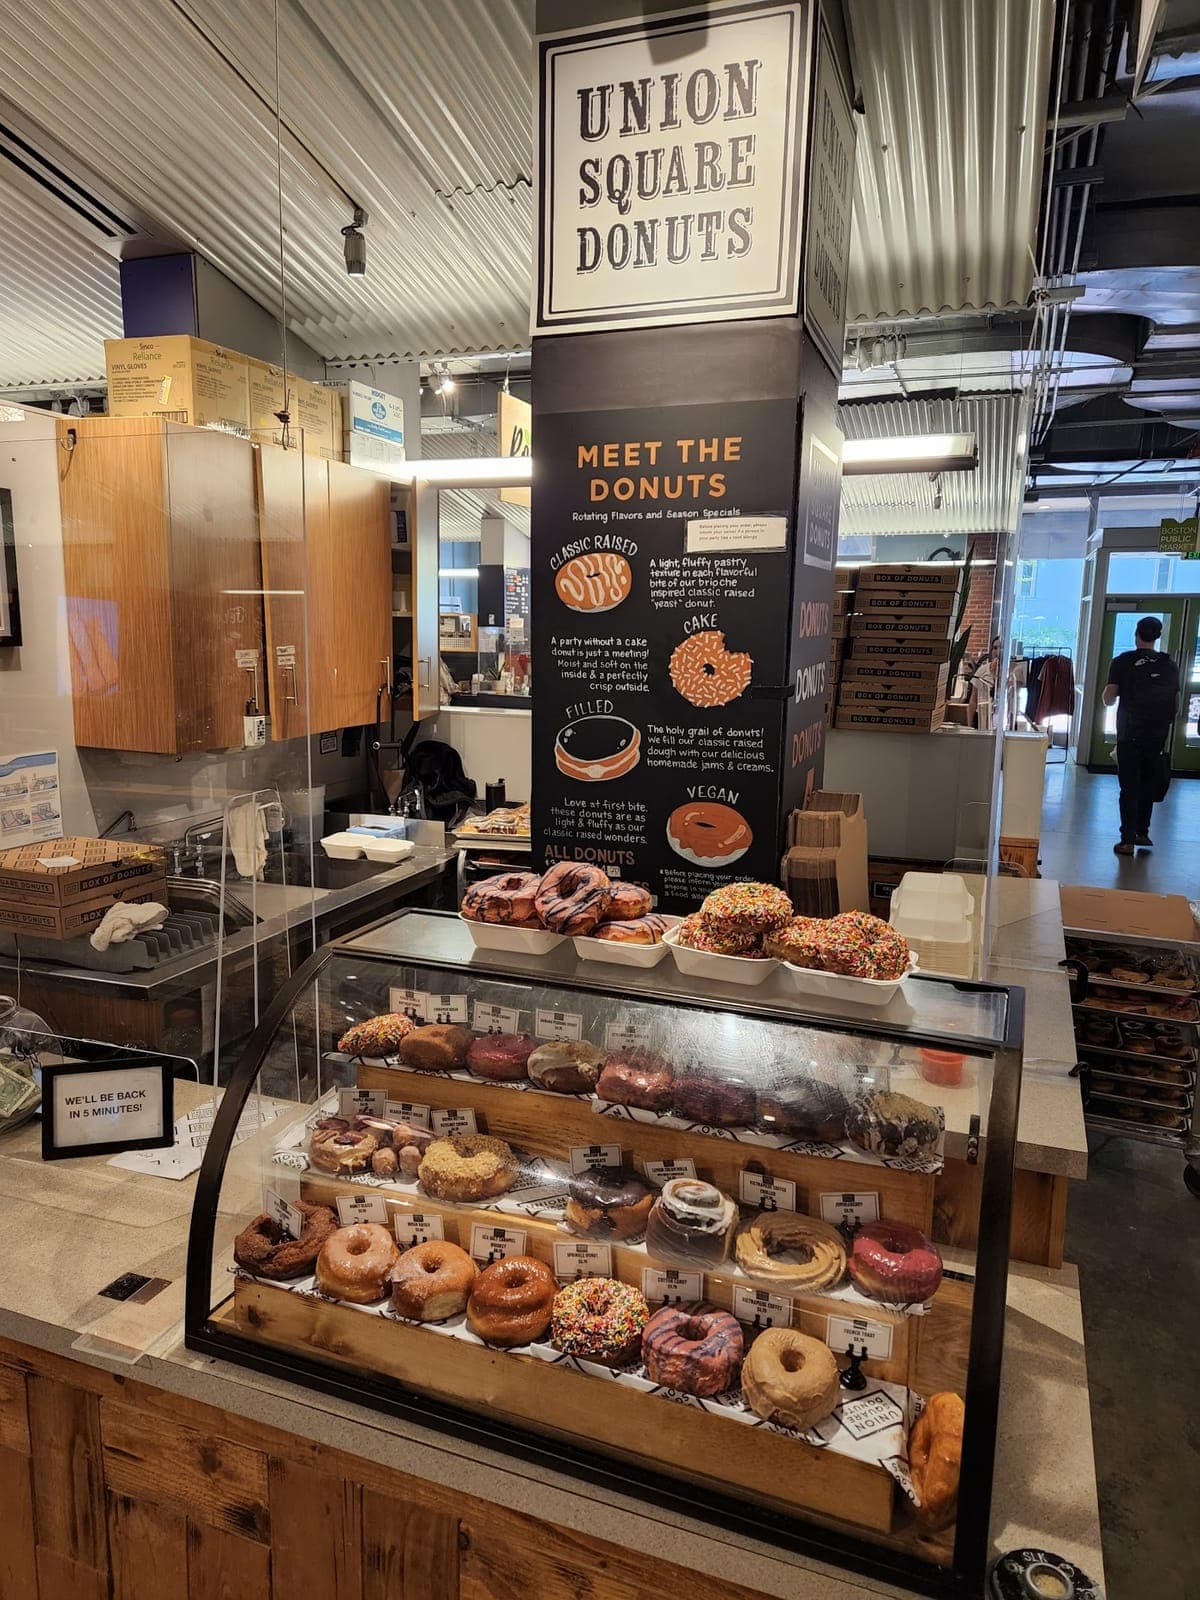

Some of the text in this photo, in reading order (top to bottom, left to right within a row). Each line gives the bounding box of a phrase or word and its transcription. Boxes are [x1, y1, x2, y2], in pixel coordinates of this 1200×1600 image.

[577, 59, 762, 142] UNION
[579, 133, 756, 215] SQUARE
[576, 206, 754, 275] DONUTS
[132, 352, 162, 361] Reliance
[577, 436, 742, 468] MEET THE
[590, 473, 728, 501] DONUTS
[572, 507, 741, 523] Rotating Flavors and Season Specials
[1161, 527, 1196, 535] BOSTON
[1160, 535, 1191, 543] PUBLIC
[550, 534, 638, 570] CLASSIC RAISED
[649, 557, 747, 570] A light, fluffy pastry
[650, 567, 757, 577] texture in each flavorful
[649, 577, 738, 588] bite of our brioche
[650, 587, 755, 599] inspired classic raised
[651, 598, 716, 610] "yeast" donut.
[683, 613, 718, 634] CAKE
[799, 601, 829, 639] DONUTS
[551, 636, 648, 647] A party without a cake
[551, 647, 576, 656] donut
[577, 648, 584, 657] is
[585, 648, 602, 659] just
[612, 648, 650, 660] meeting!
[557, 659, 581, 668] Moist
[582, 659, 598, 668] and
[600, 659, 617, 668] soft
[633, 660, 648, 670] the
[561, 669, 587, 679] inside
[589, 669, 597, 679] &
[606, 670, 648, 682] perfectly
[795, 661, 825, 704] DONUTS
[589, 681, 613, 693] crisp
[566, 699, 614, 719] FILLED
[647, 724, 765, 738] The holy grail of donuts!
[662, 735, 676, 745] fill
[678, 737, 694, 745] our
[698, 738, 731, 747] classic
[733, 738, 763, 748] raised
[791, 721, 822, 768] DONUTS
[647, 746, 766, 760] dough with our delicious
[646, 757, 774, 773] homemade jams & creams.
[686, 785, 739, 805] VEGAN
[564, 796, 587, 808] Love
[589, 799, 601, 808] at
[602, 799, 625, 811] first
[550, 806, 646, 822] these donuts are as
[555, 817, 645, 832] light & fluffy as our
[543, 827, 574, 838] classic
[576, 830, 602, 840] raised
[544, 844, 571, 859] ALL
[574, 847, 636, 865] DONUTS
[81, 864, 151, 889] BOX OF DONUTS
[664, 876, 686, 884] please
[687, 871, 715, 881] placing
[21, 882, 50, 891] DONUTS
[22, 915, 51, 925] DONUTS
[84, 910, 101, 921] BOX
[65, 1089, 146, 1105] WE'LL BE BACK
[69, 1103, 142, 1119] IN 5 MINUTES!
[843, 1328, 875, 1338] FRENCH TOAST
[845, 1402, 891, 1425] SQUARE
[854, 1409, 899, 1433] UNION
